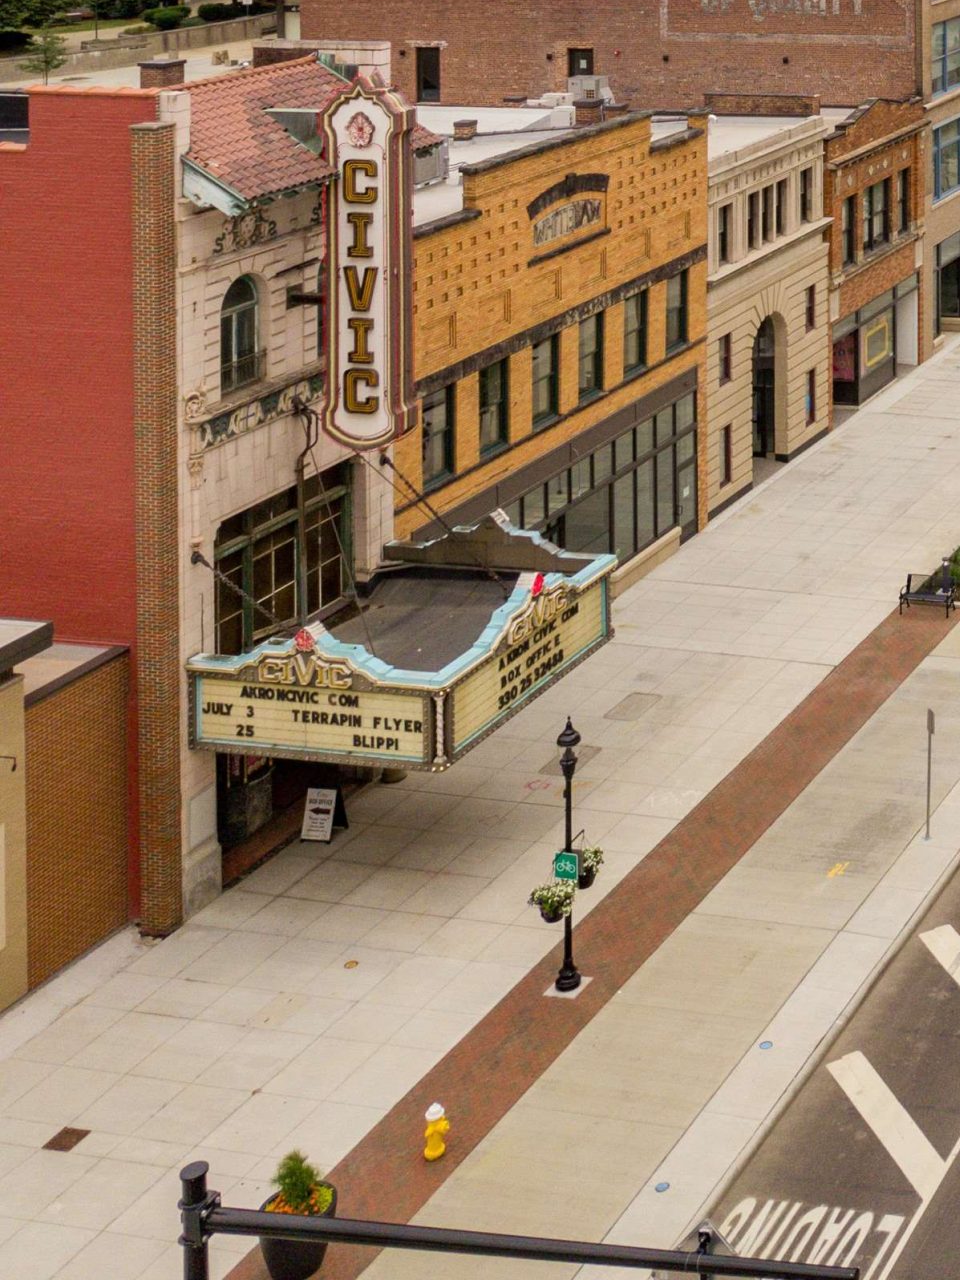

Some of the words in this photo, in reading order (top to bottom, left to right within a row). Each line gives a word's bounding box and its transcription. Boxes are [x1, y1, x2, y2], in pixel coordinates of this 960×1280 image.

[343, 159, 380, 414] CIVIC
[508, 589, 569, 645] CIVIC
[533, 621, 557, 644] CIVIC
[561, 603, 579, 623] COM
[258, 654, 352, 689] CIVIC
[500, 665, 521, 689] BOX
[526, 634, 561, 667] OFFICE
[328, 693, 359, 708] COM
[498, 688, 518, 710] 330
[202, 702, 233, 716] JULY
[246, 705, 254, 718] 3
[292, 709, 362, 727] TERRAPIN
[373, 717, 423, 733] FLYER
[236, 724, 254, 737] 25
[353, 734, 399, 751] BLIPPI
